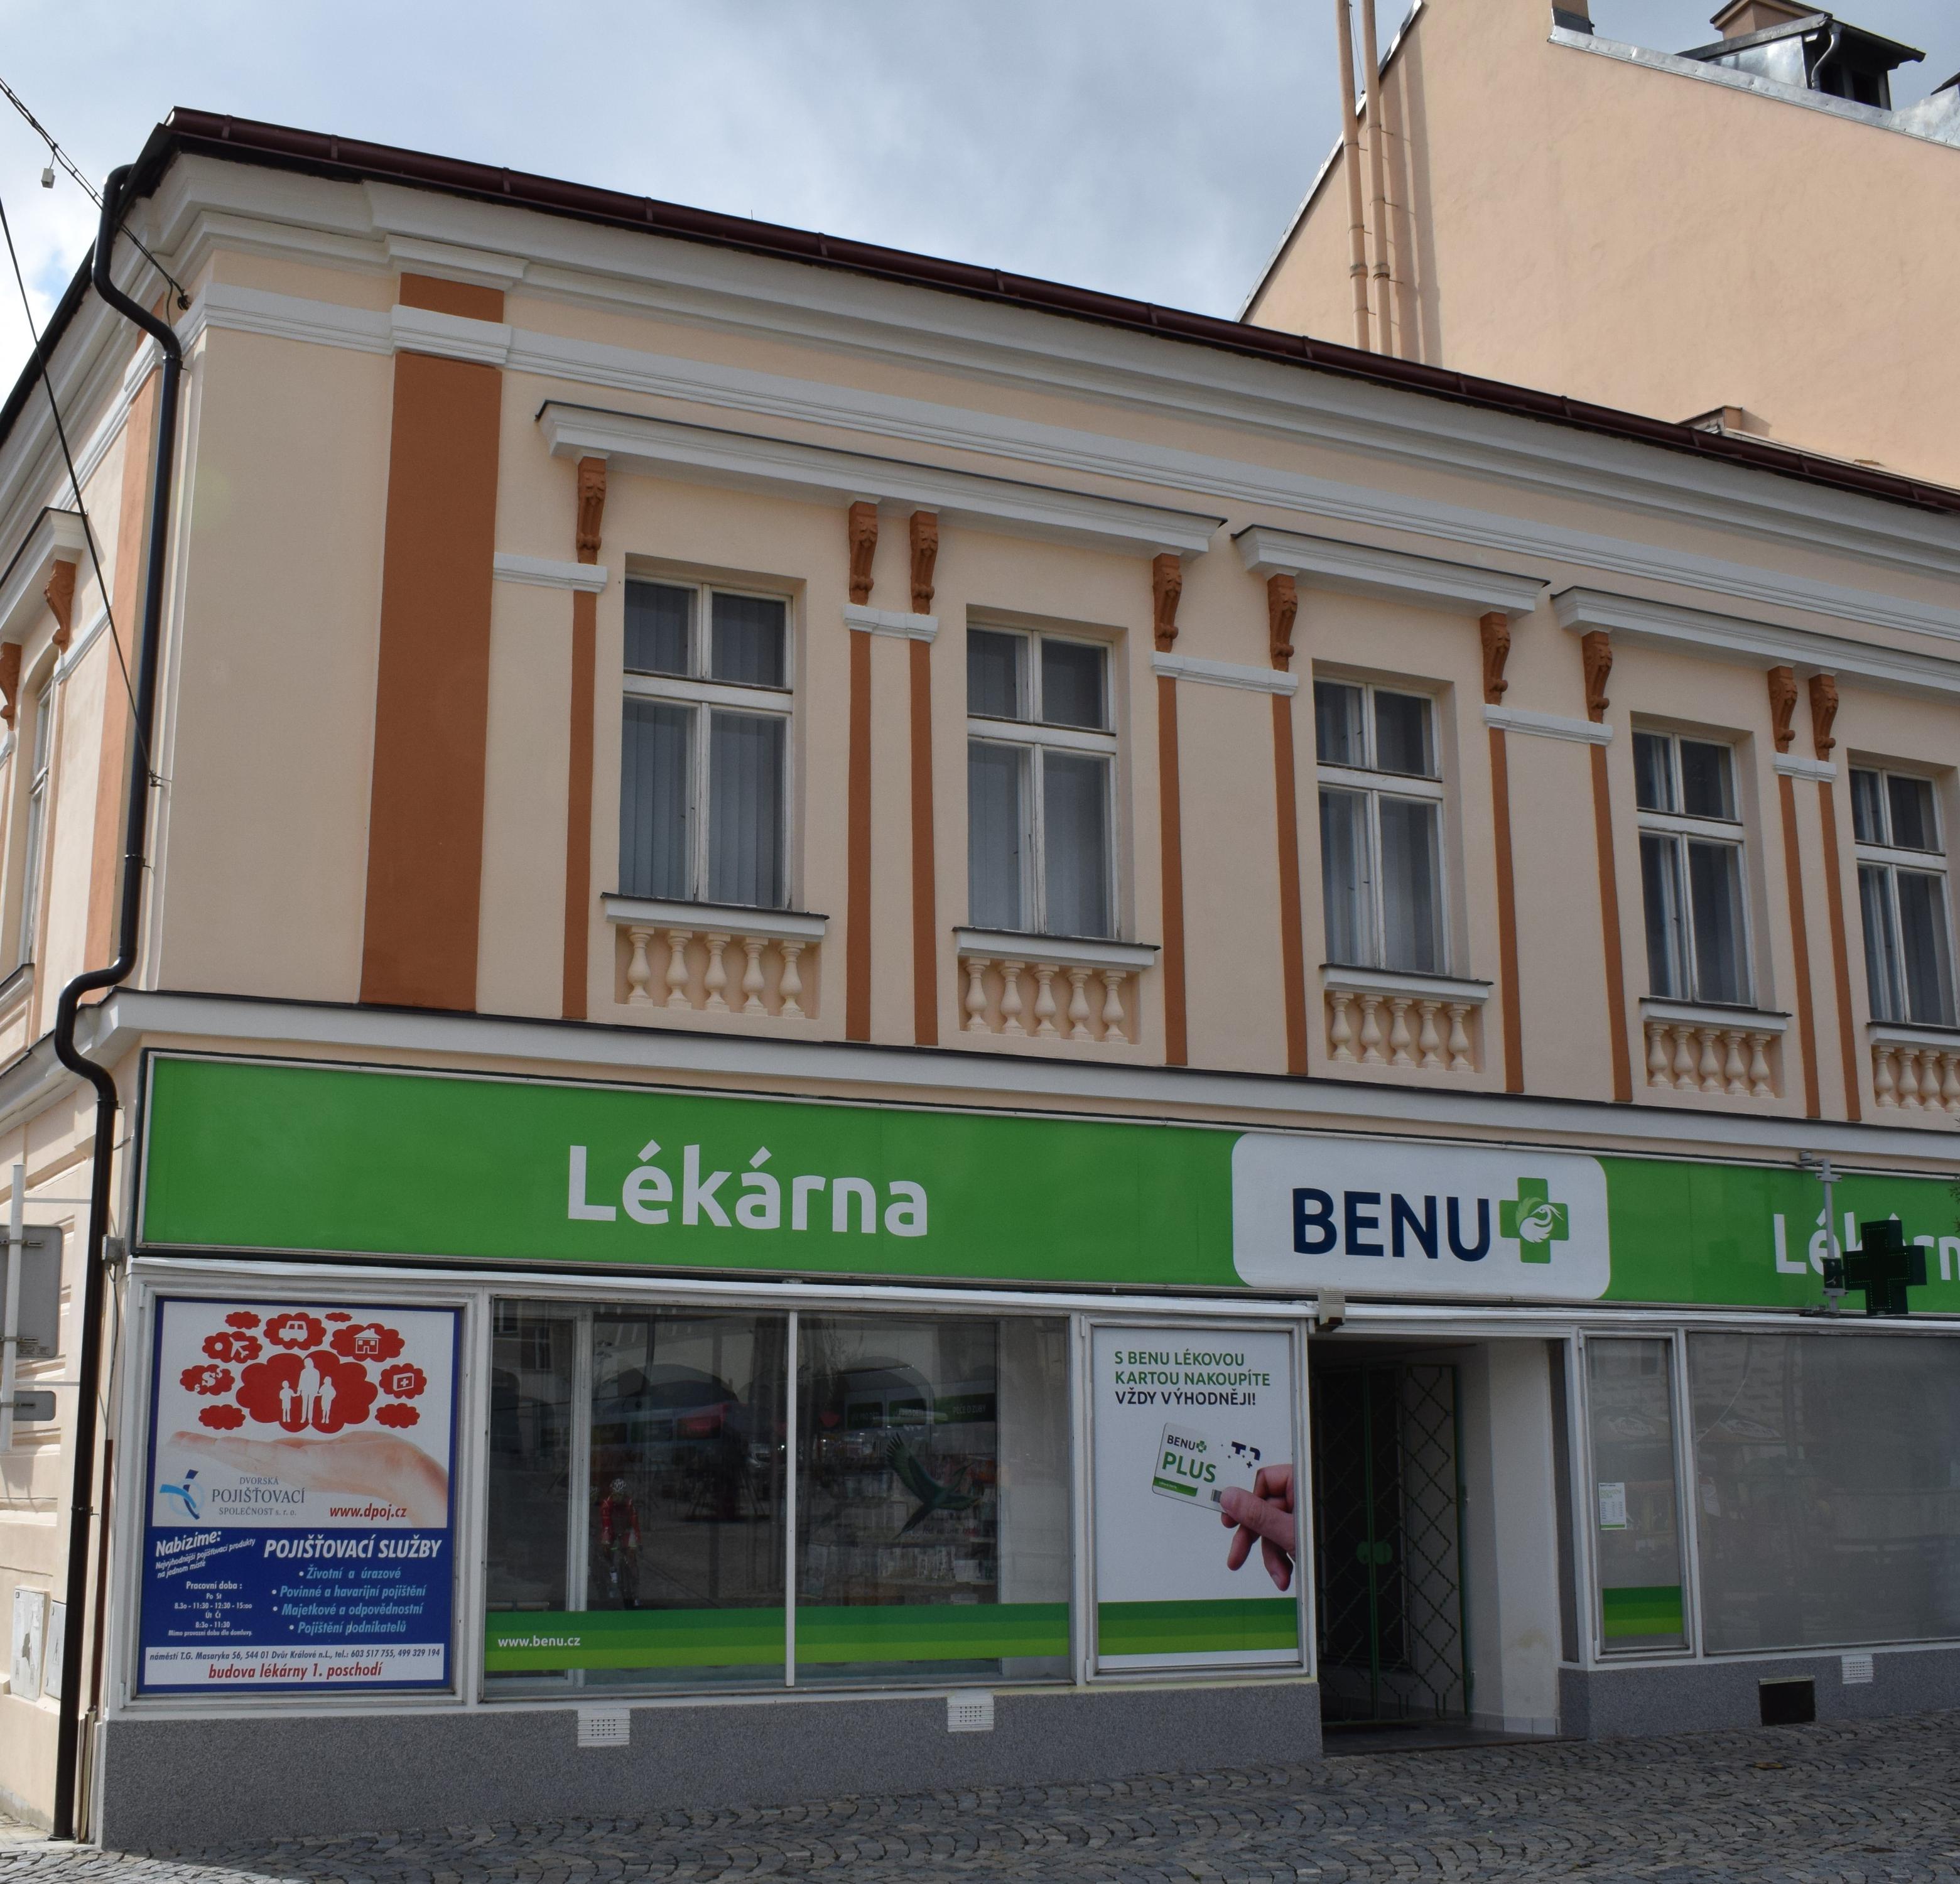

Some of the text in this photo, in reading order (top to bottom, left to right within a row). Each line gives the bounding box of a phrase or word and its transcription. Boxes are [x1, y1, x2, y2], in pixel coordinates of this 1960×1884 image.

[568, 1139, 928, 1237] Lékárna
[1292, 1187, 1490, 1262] BENU
[1115, 1348, 1245, 1366] S BENU LÉKOVOU
[1115, 1369, 1271, 1387] KARTOU NAKOUPÍTE
[1115, 1387, 1256, 1405] VŽDY VÝHODNĚJI!
[1167, 1434, 1196, 1451] BENU
[1162, 1451, 1216, 1483] PLUS
[240, 1476, 279, 1485] DVORSKÁ
[212, 1486, 305, 1503] POJIŠŤOVACÍ
[219, 1506, 274, 1516] SPOLEČNOST
[330, 1502, 407, 1520] www.dpoj.cz
[156, 1531, 222, 1557] Nabízíme:
[229, 1538, 256, 1552] produkty
[264, 1534, 442, 1558] POJIŠŤOVACÍ SLUŽBY
[166, 1565, 188, 1579] jednom
[306, 1564, 401, 1579] Životní a úrazové
[186, 1581, 217, 1589] Pracovní
[219, 1581, 237, 1589] doba
[279, 1584, 427, 1600] Povinné a havarijní pojištění
[281, 1602, 425, 1618] Majetkové a odpovědnostní
[298, 1620, 407, 1636] Pojištění podnikatelů
[498, 1635, 581, 1647] www.benu.cz
[149, 1652, 178, 1660] náměstí
[195, 1652, 230, 1661] Masaryka
[232, 1651, 243, 1660] 56,
[245, 1650, 258, 1659] 544
[260, 1650, 269, 1659] 01
[271, 1650, 288, 1659] Dvůr
[290, 1650, 316, 1659] Králové
[335, 1650, 349, 1658] tel.:
[350, 1650, 364, 1658] 603
[366, 1649, 379, 1658] 517
[381, 1649, 396, 1659] 755,
[398, 1648, 411, 1657] 499
[412, 1648, 426, 1657] 329
[428, 1648, 440, 1657] 194
[208, 1661, 384, 1680] budova lékárny 1. poschodí
